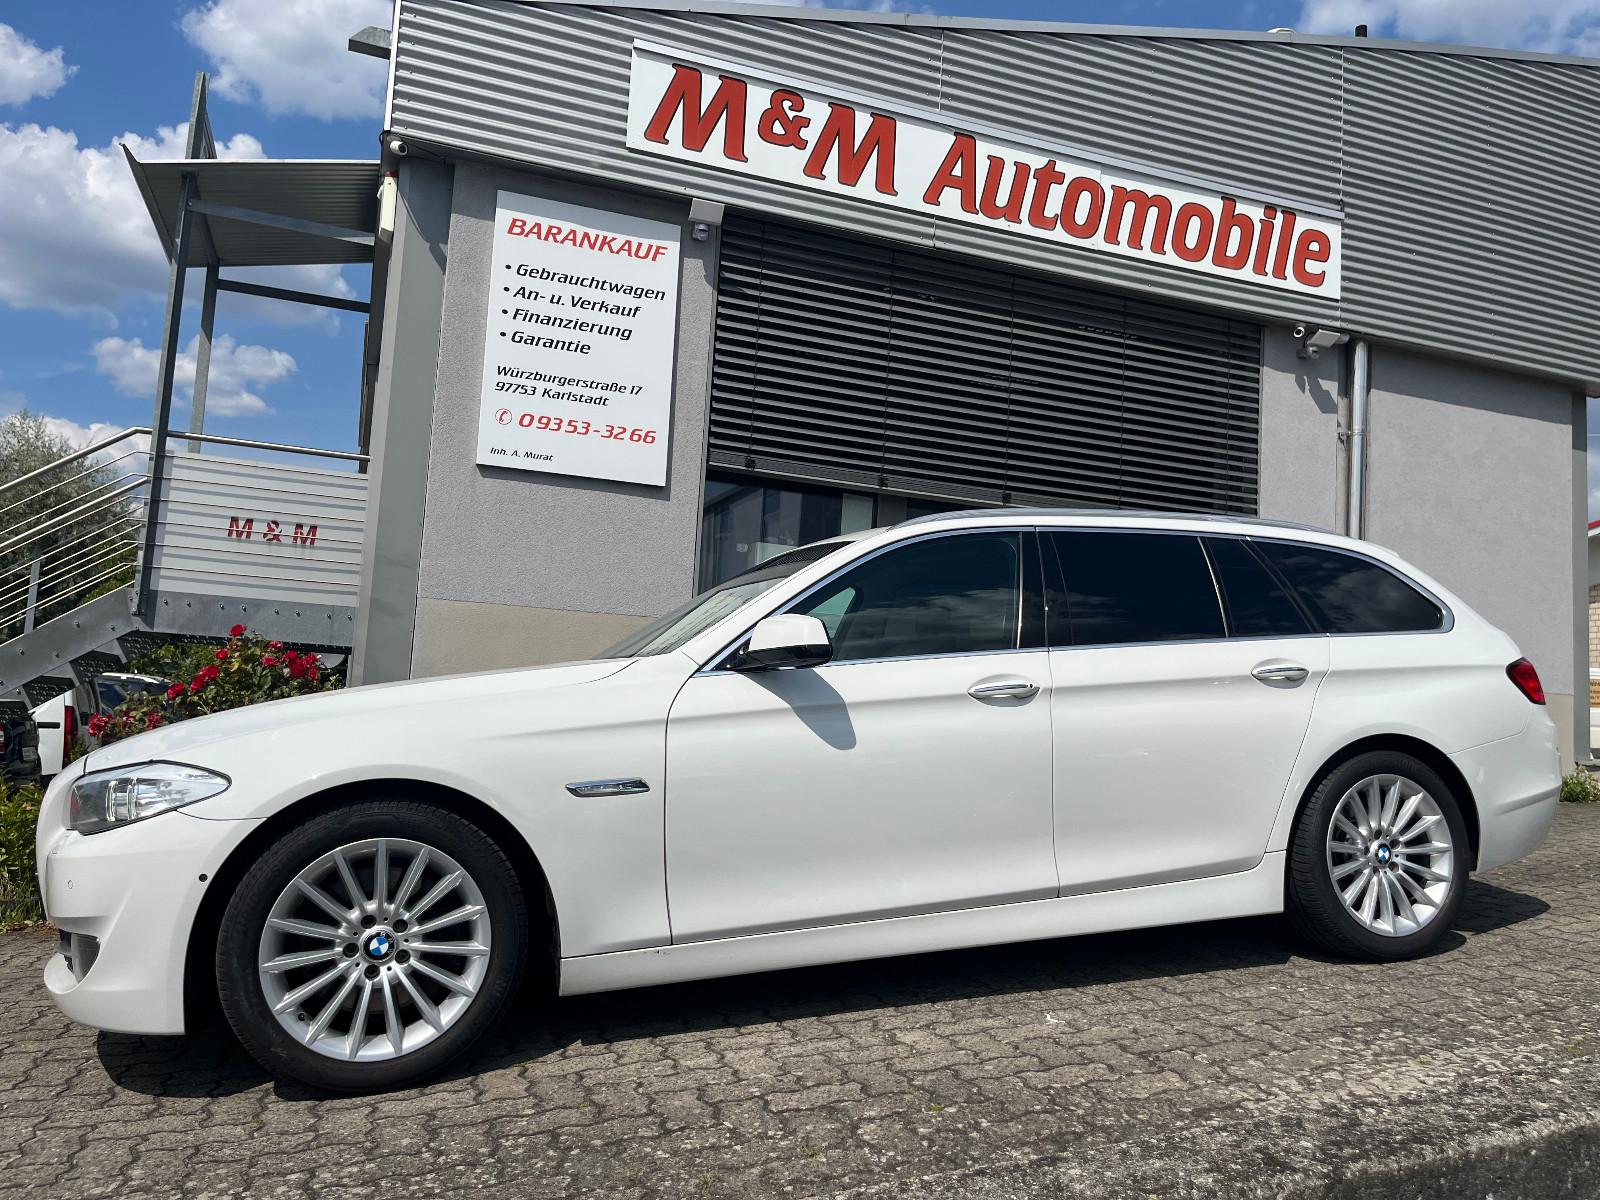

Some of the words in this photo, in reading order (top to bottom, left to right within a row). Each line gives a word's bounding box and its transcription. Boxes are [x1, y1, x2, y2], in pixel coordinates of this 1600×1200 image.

[644, 63, 898, 196] M&M
[922, 131, 1332, 288] Automobile
[507, 217, 668, 262] BARANKAUF
[516, 263, 666, 301] Gebrauchtwagen
[513, 286, 546, 301] An-
[549, 293, 565, 306] u.
[570, 295, 642, 318] Verkauf
[512, 308, 633, 341] Finanzierung
[510, 331, 592, 355] Garantie
[495, 381, 537, 396] 97753
[542, 387, 610, 407] Karlstadt
[496, 365, 627, 394] Würzburgerstraße
[629, 385, 643, 396] 17
[489, 447, 508, 456] Inh.
[510, 449, 521, 458] A.
[523, 451, 554, 462] Murat
